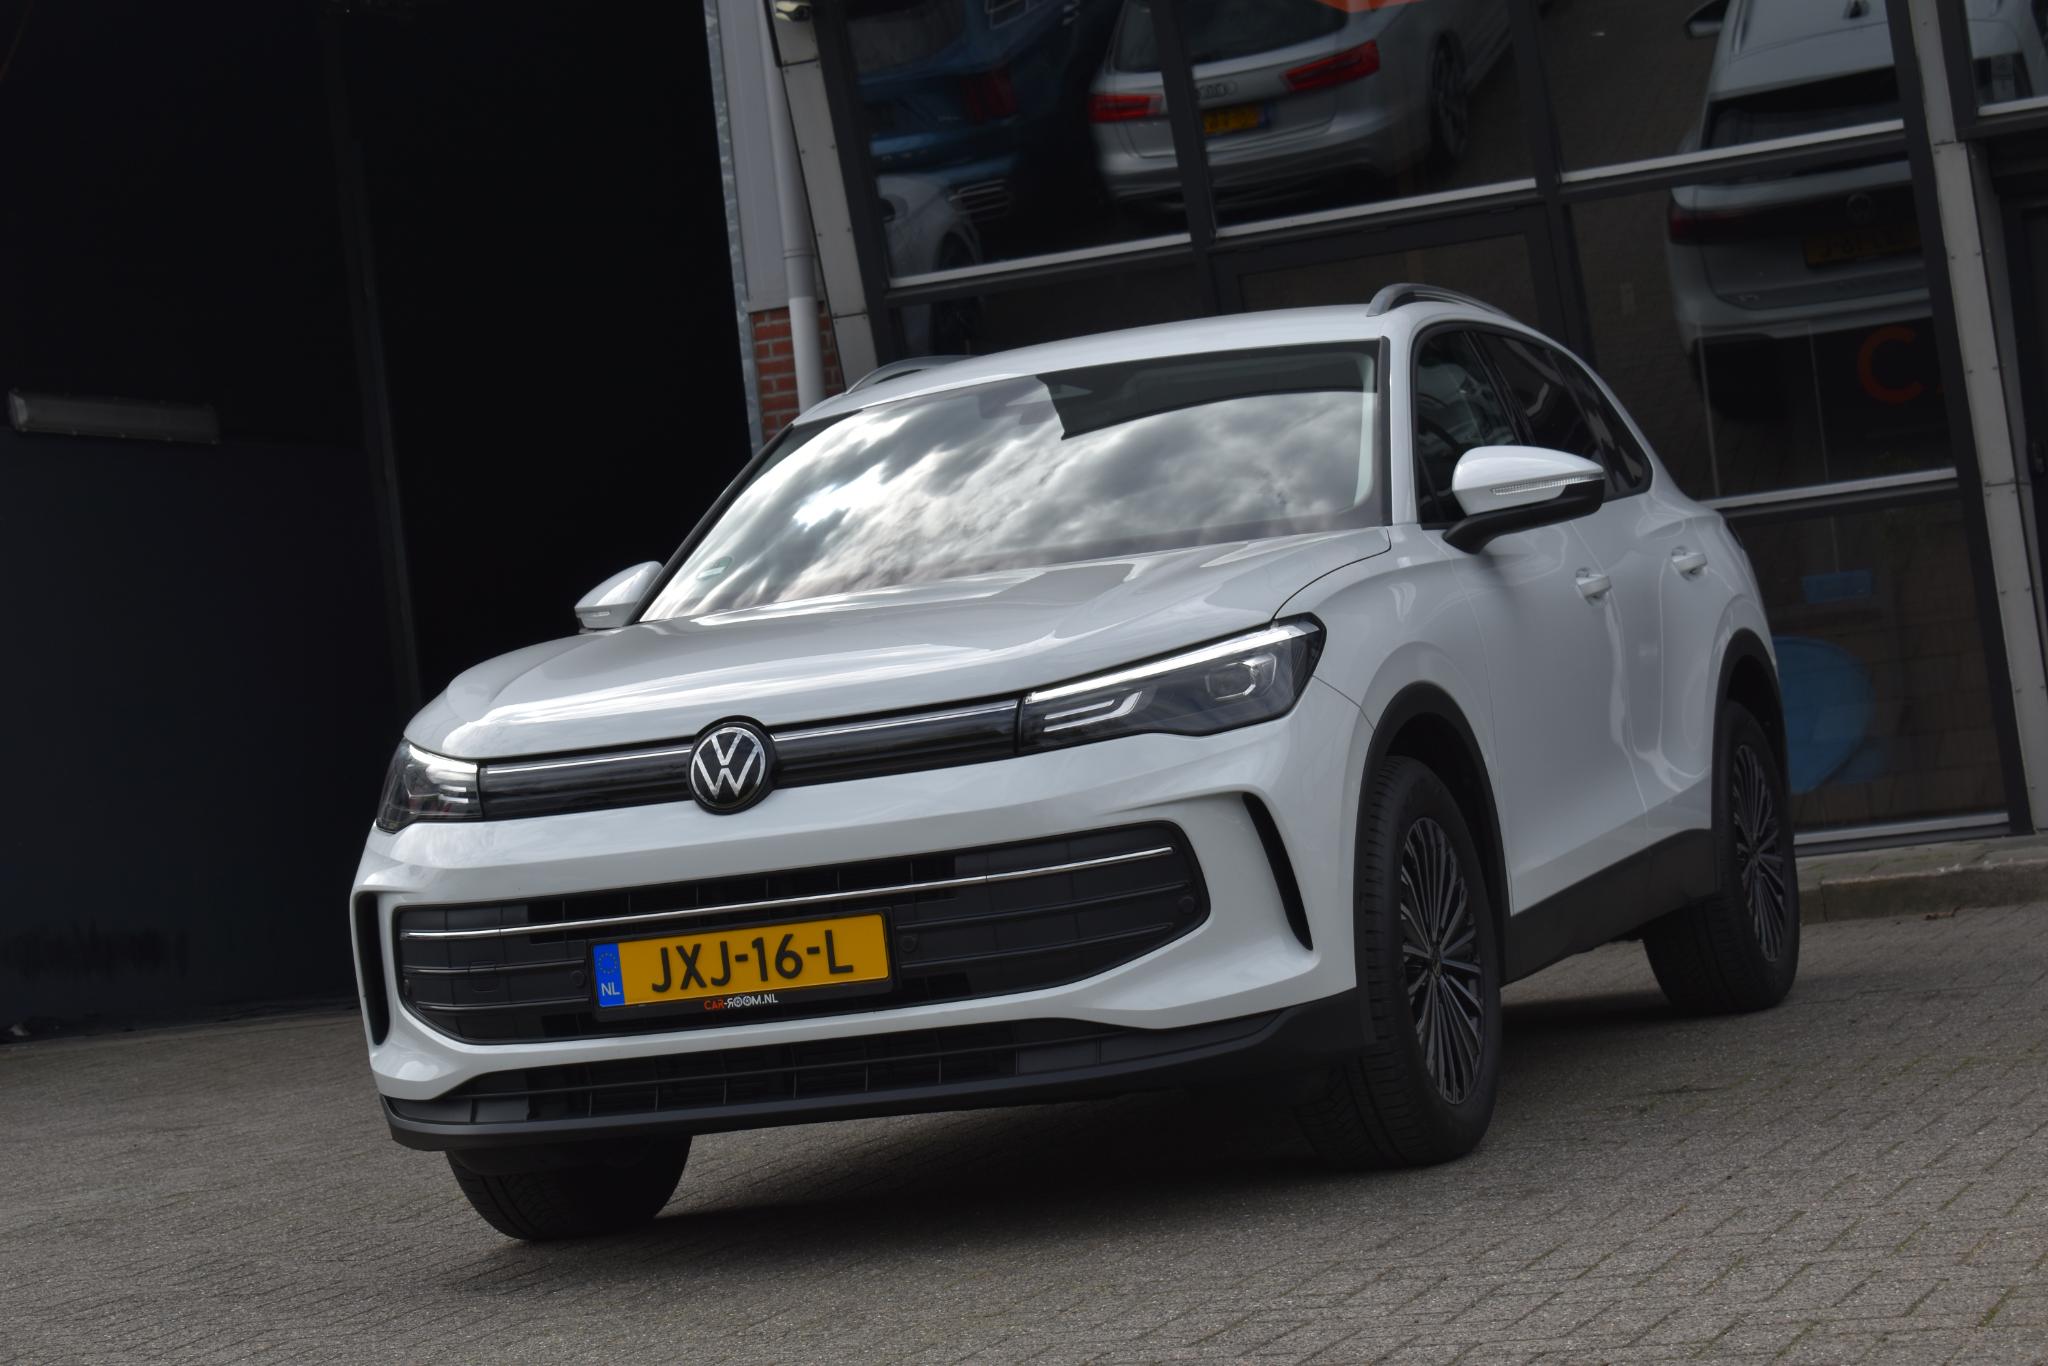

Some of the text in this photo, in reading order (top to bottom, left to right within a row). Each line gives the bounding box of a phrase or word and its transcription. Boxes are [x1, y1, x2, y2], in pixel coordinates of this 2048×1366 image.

[692, 727, 765, 805] VW
[601, 982, 621, 996] NL
[651, 929, 854, 993] JXJ-16-L
